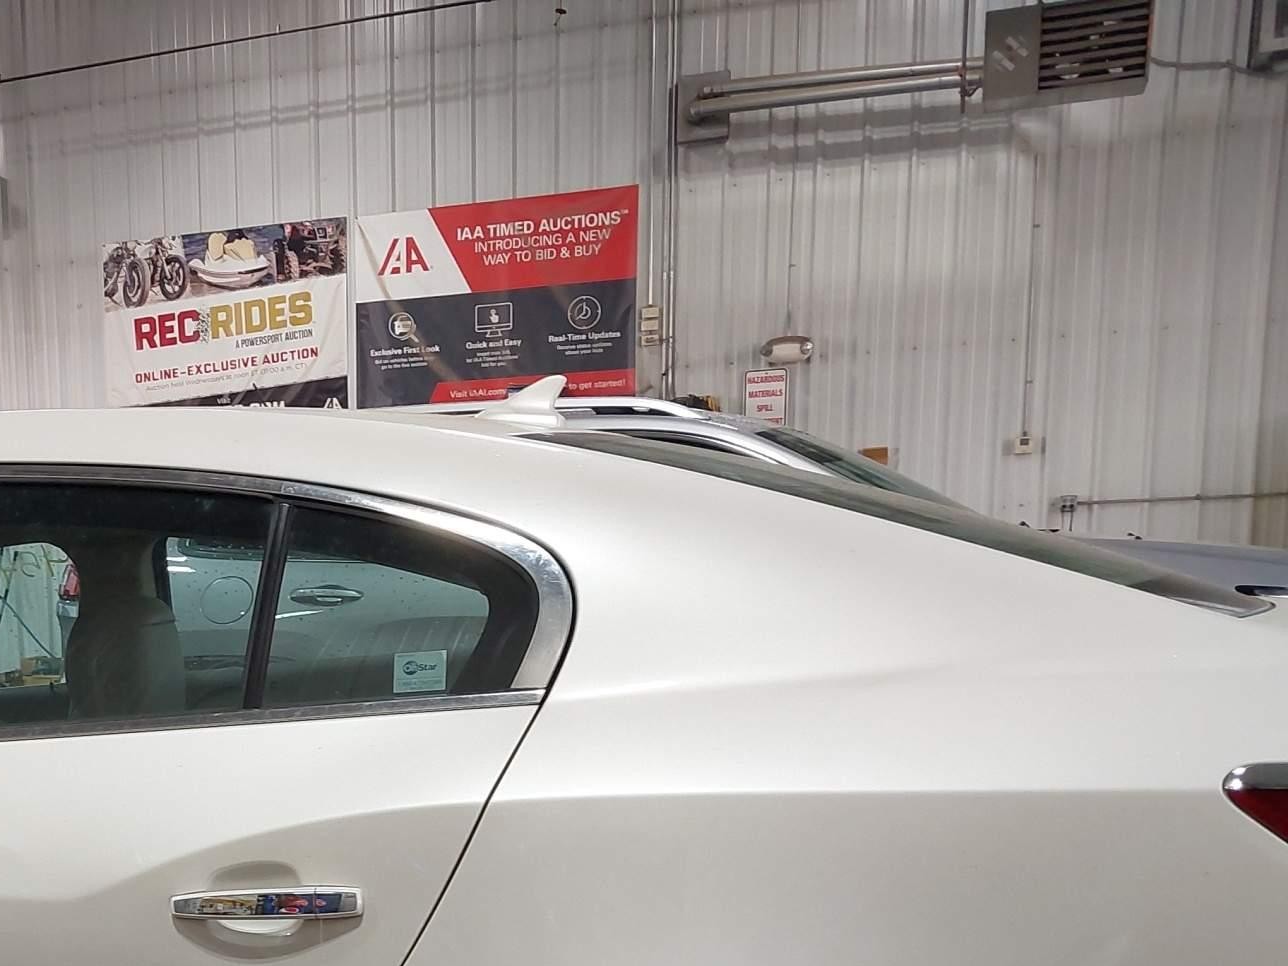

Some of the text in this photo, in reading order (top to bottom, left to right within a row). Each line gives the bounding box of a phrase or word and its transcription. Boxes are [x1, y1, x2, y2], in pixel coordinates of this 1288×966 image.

[457, 225, 484, 242] IAA
[486, 220, 535, 239] TIMED
[474, 228, 611, 254] INTRODUCING A NEW
[483, 243, 602, 267] WAY TO BID & BUY
[134, 291, 313, 350] REC RIDES
[241, 333, 283, 348] POWERSPORT
[284, 328, 313, 342] AUCTION
[403, 346, 420, 354] First
[135, 346, 319, 384] ONLINE-EXCLUSIVE AUCTION
[579, 381, 593, 392] get
